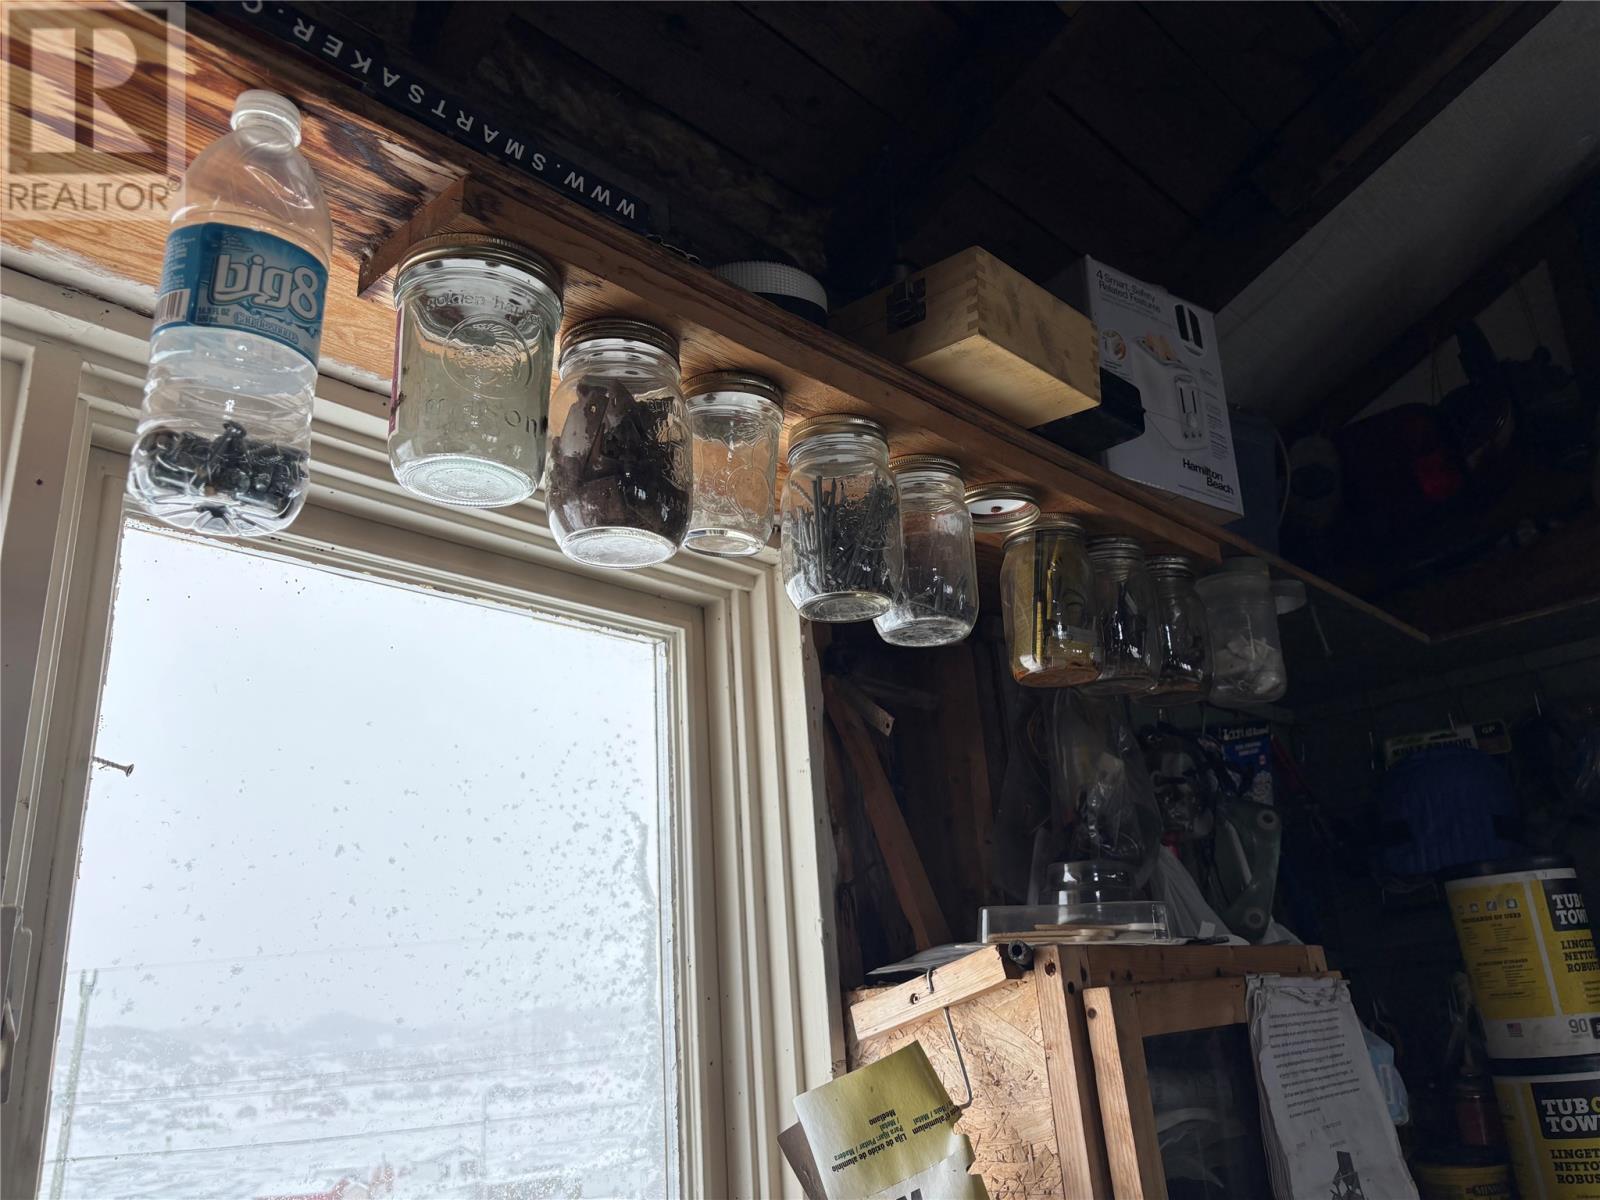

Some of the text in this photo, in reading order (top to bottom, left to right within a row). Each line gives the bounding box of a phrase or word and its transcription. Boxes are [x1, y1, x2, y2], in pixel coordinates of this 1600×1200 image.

[213, 254, 319, 320] big8
[1182, 458, 1223, 481] Hamilton
[1206, 476, 1234, 495] Beach
[1568, 1018, 1589, 1034] 90
[868, 1109, 896, 1126] Mediano
[834, 1147, 857, 1161] Madera
